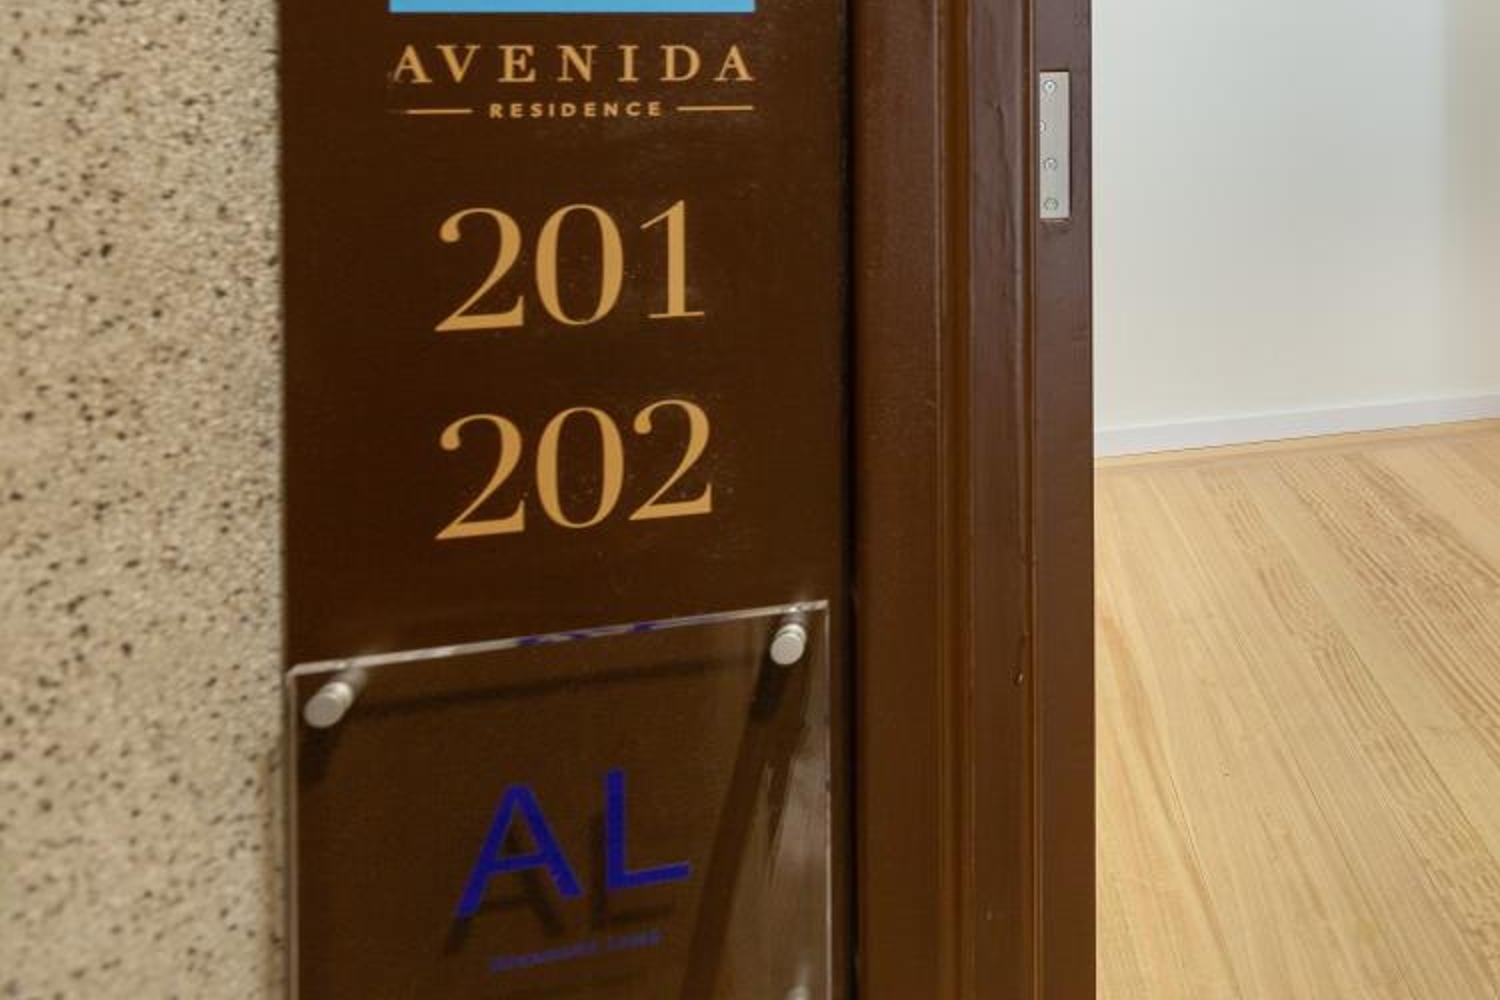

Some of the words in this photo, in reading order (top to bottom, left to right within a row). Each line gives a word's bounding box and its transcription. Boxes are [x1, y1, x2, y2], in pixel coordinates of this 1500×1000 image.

[391, 44, 756, 83] AVENIDA
[489, 101, 662, 119] RESIDENCE
[434, 199, 705, 332] 201
[434, 399, 713, 540] 202
[455, 769, 692, 919] AL
